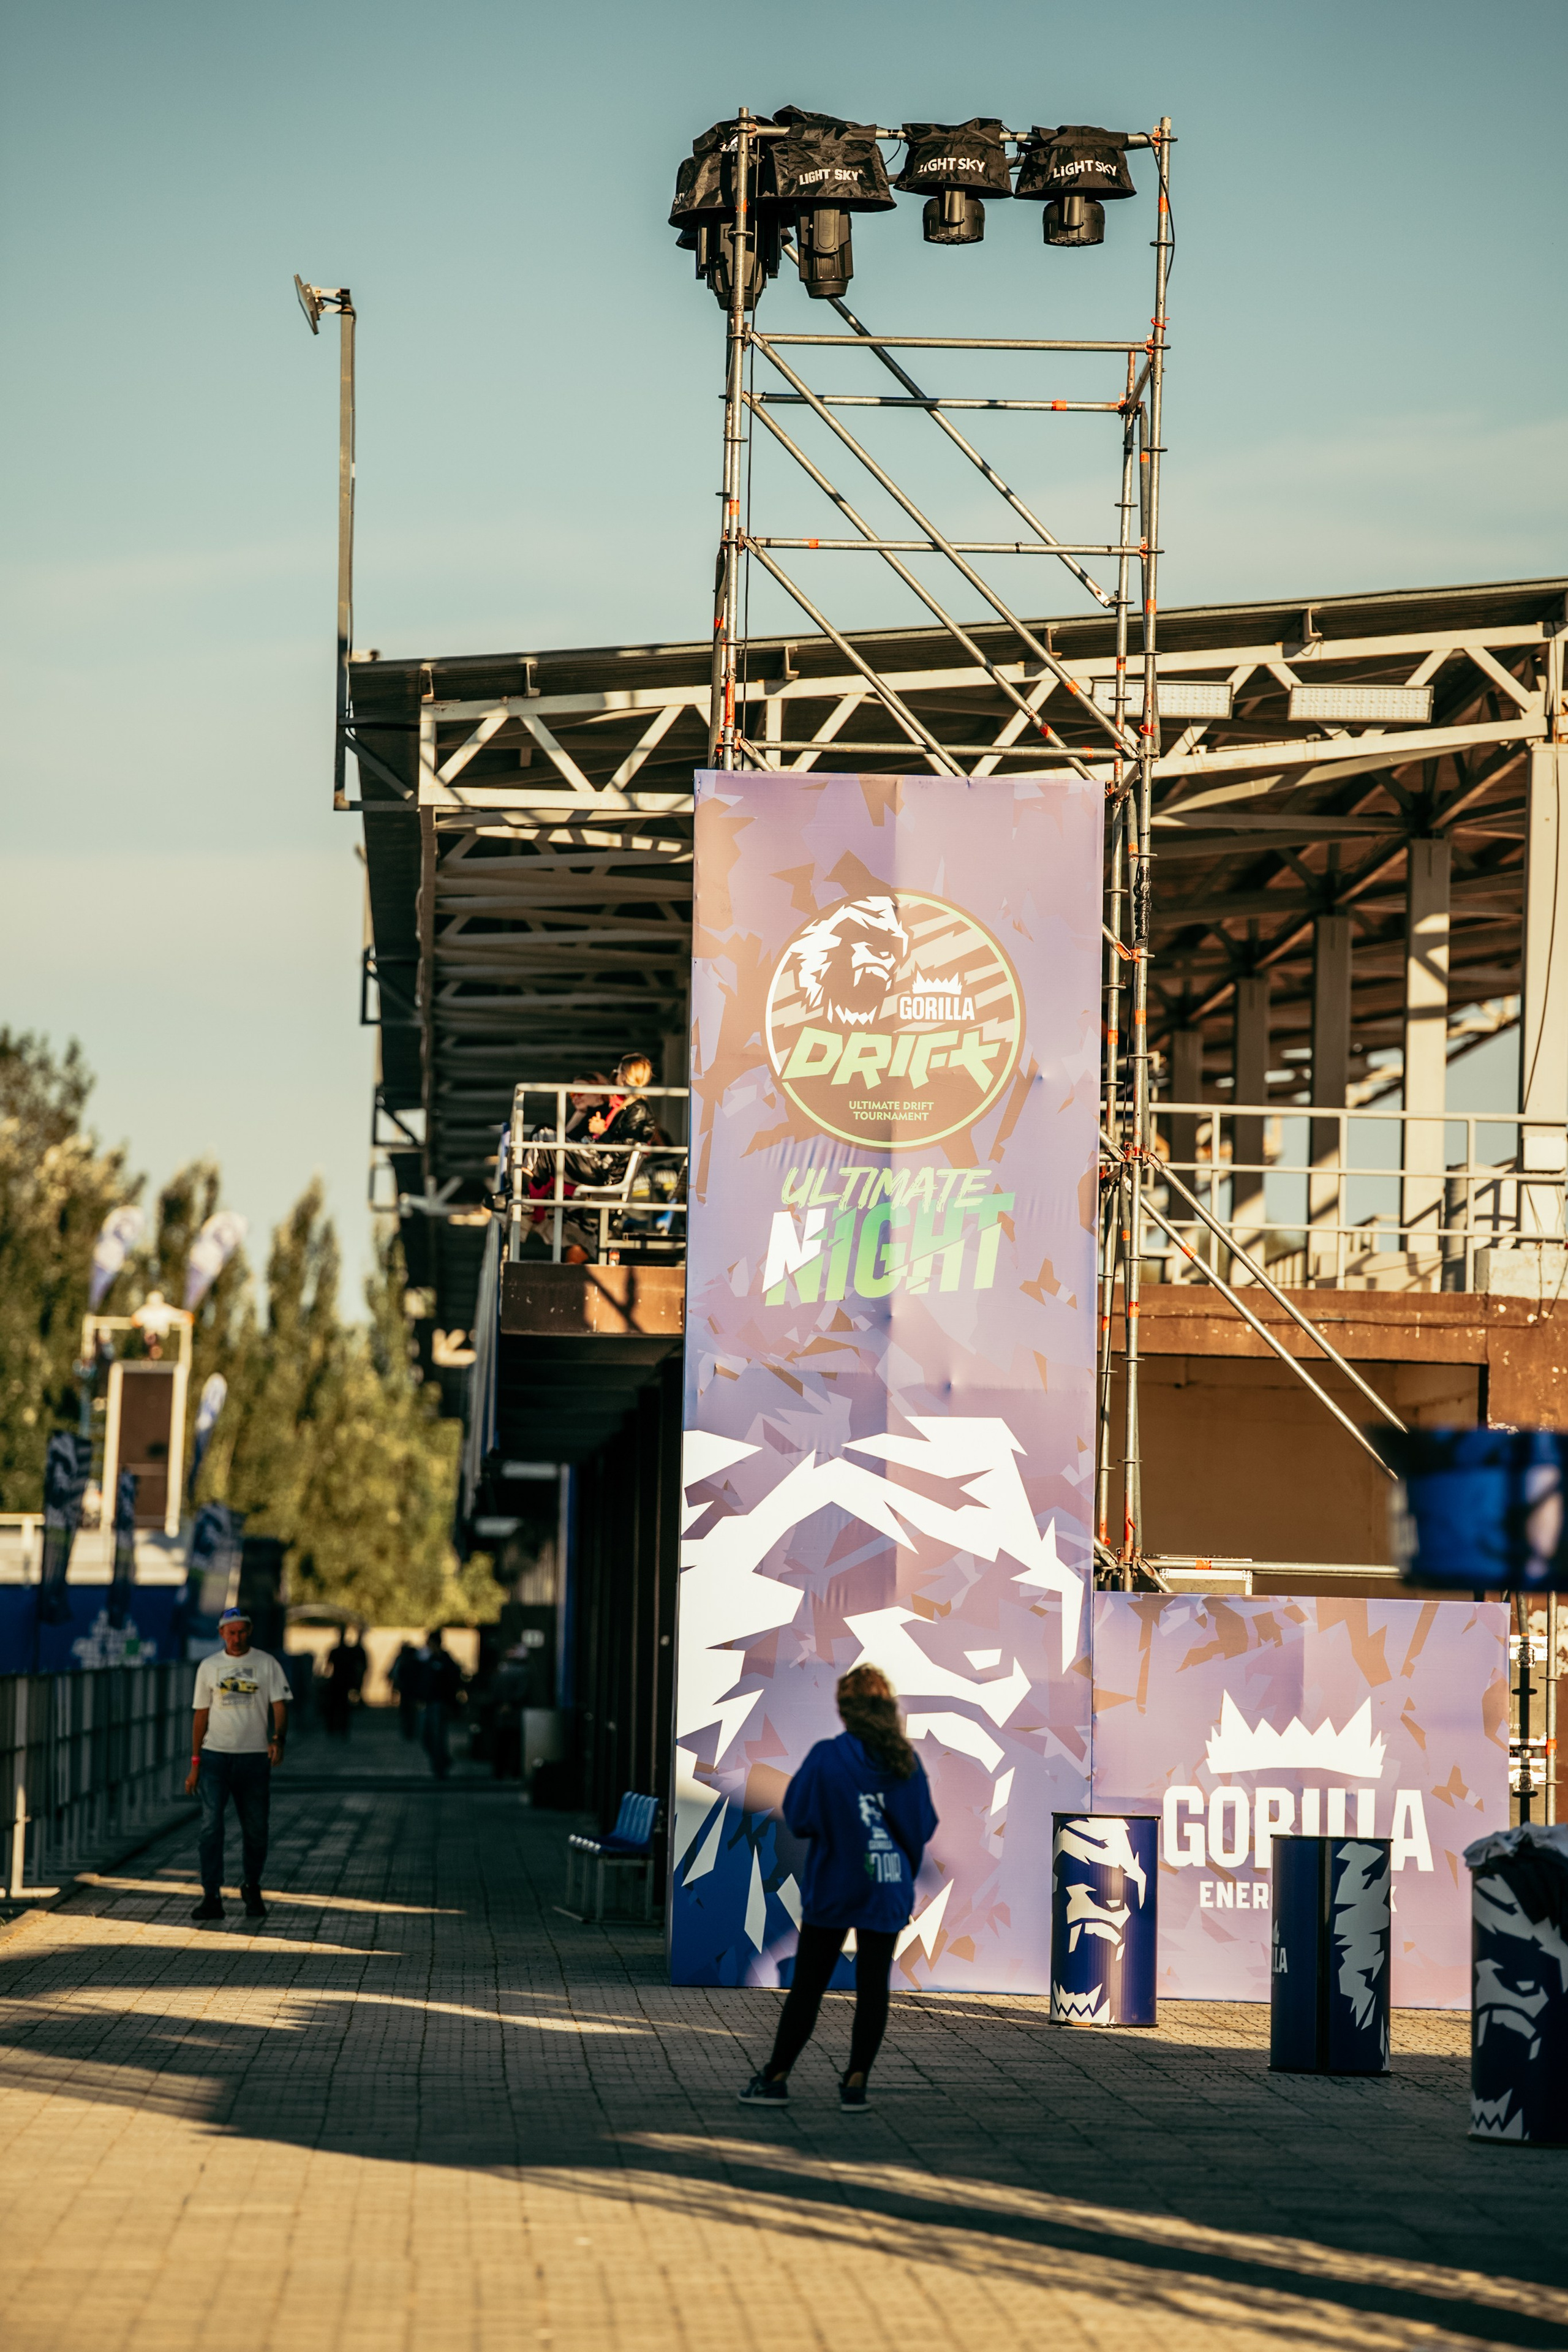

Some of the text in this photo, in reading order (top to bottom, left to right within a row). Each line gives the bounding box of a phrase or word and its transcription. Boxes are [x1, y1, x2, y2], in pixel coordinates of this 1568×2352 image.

[917, 157, 986, 173] LIGHT SKY
[1054, 160, 1117, 178] LIGHT SKY
[799, 168, 831, 186] LIGHT
[899, 996, 975, 1020] GORILLA
[782, 1027, 1000, 1094] DRIFT
[848, 1100, 935, 1110] ULTIMATE DRIFT
[853, 1111, 929, 1121] TOURNAMENT
[781, 1166, 992, 1214] ULTIMATE
[761, 1192, 1016, 1306] NIGHT
[1199, 1880, 1273, 1909] ENER
